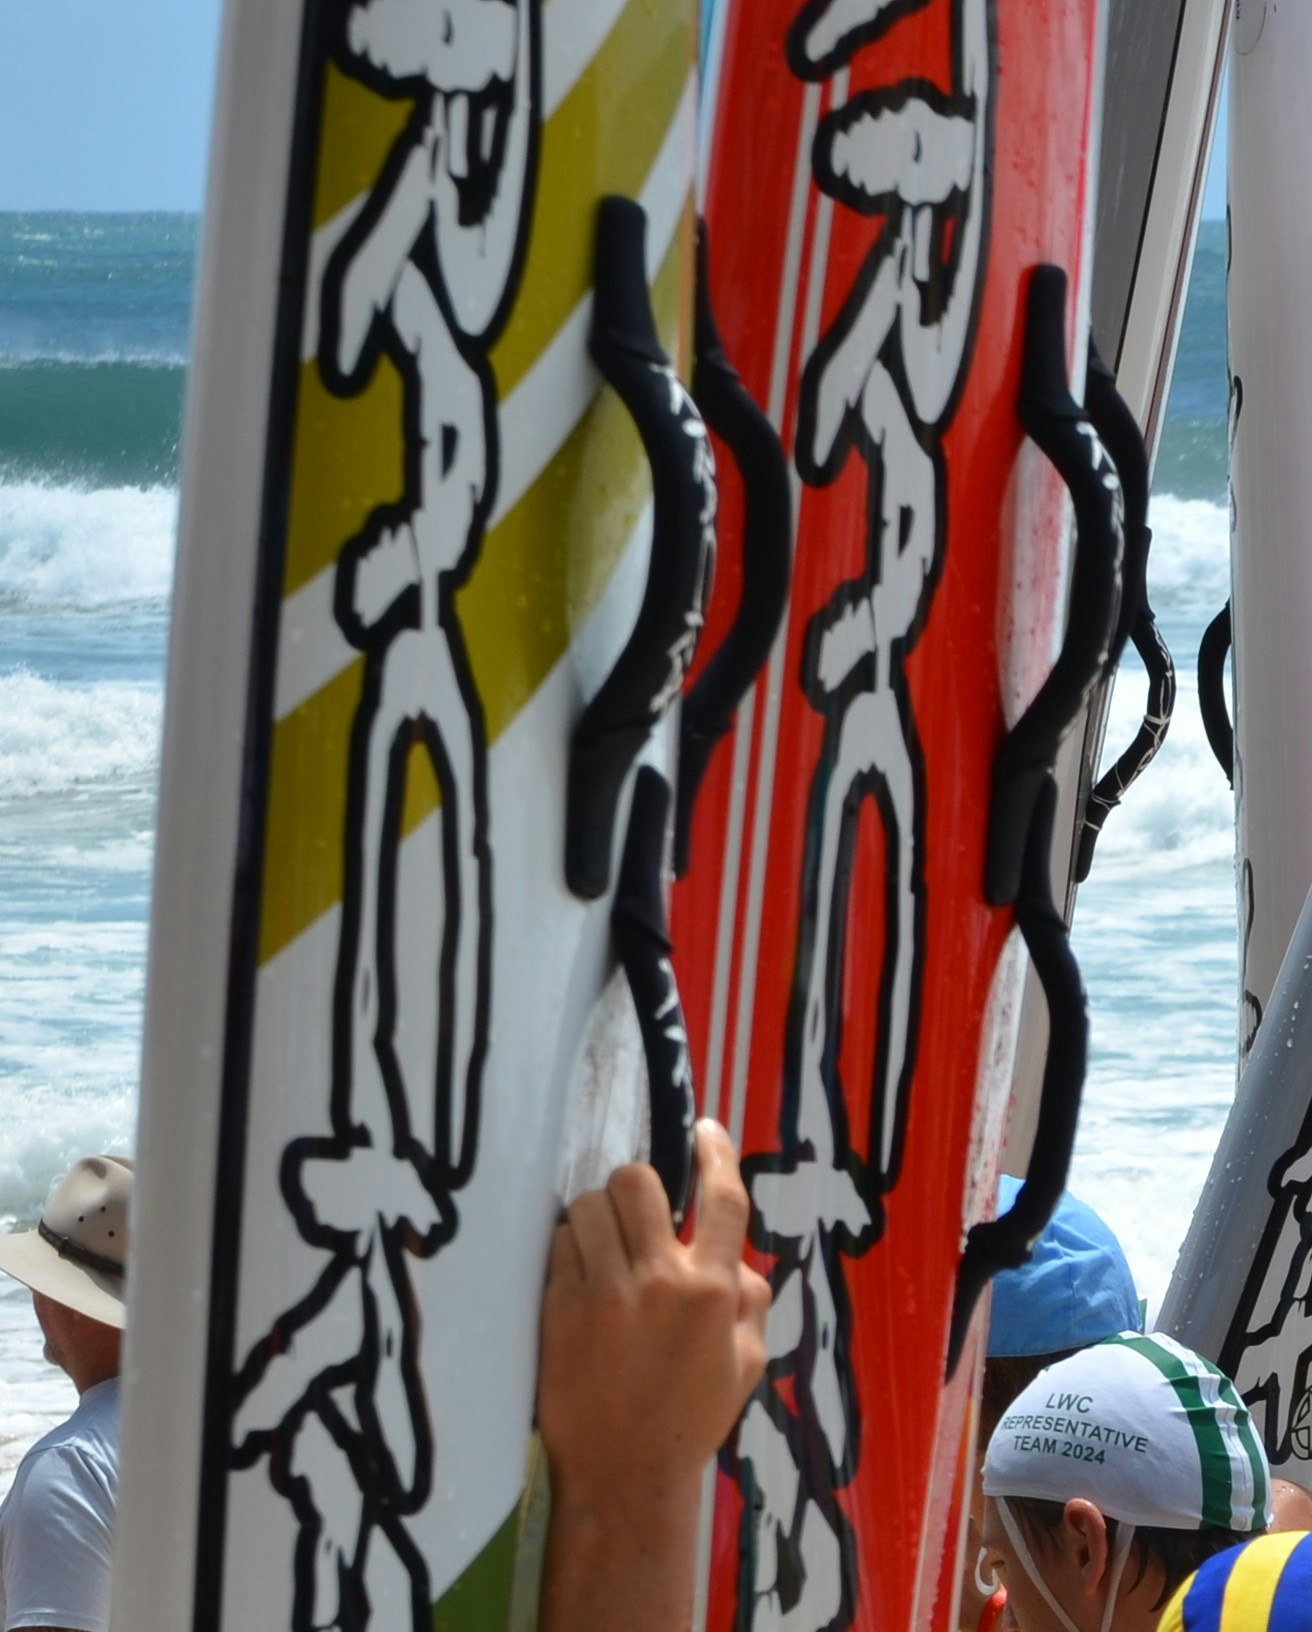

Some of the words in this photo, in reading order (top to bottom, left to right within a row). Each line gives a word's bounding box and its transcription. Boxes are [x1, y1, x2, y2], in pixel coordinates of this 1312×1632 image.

[1045, 1392, 1093, 1414] LWC
[1001, 1415, 1149, 1454] REPRESENTATIVE
[1013, 1435, 1057, 1455] TEAM
[1061, 1441, 1106, 1466] 2024
